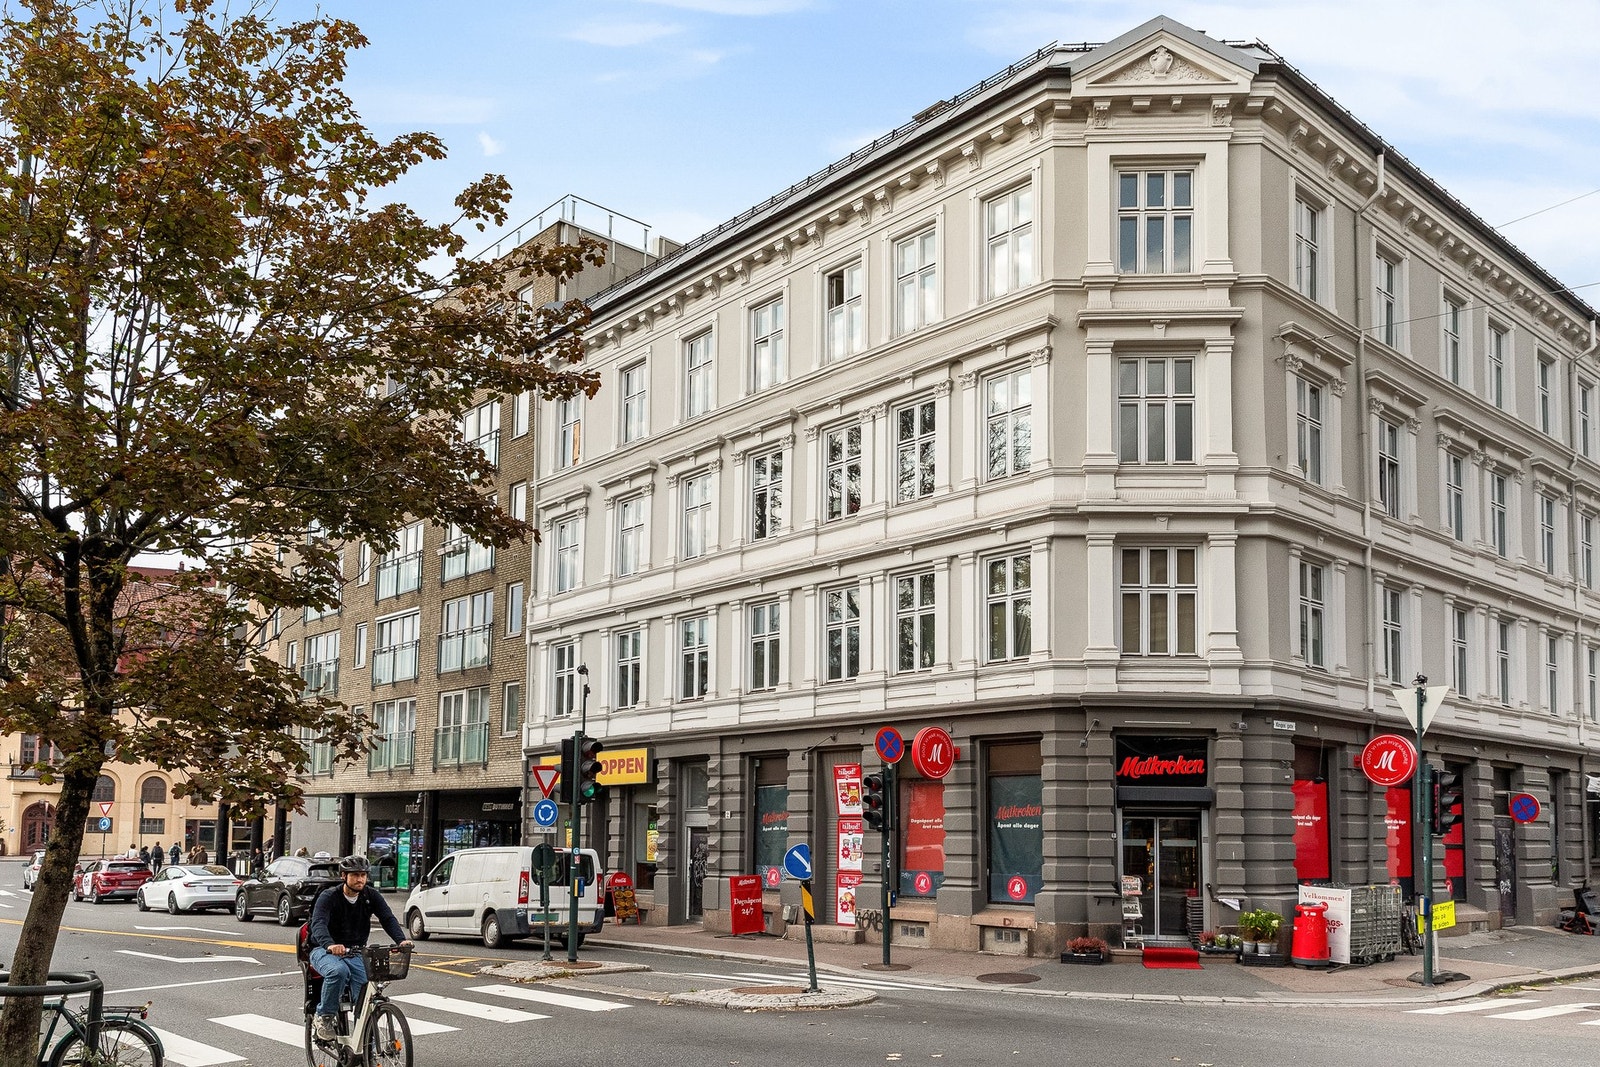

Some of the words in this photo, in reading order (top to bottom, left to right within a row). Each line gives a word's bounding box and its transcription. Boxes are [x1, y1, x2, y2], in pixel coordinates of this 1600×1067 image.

[1115, 756, 1205, 778] Matkroken
[405, 802, 420, 814] notar
[994, 804, 1042, 821] Matkroken
[734, 898, 762, 906] Døgnåpent
[1304, 892, 1345, 902] Velkommen!
[742, 906, 754, 916] 24/7
